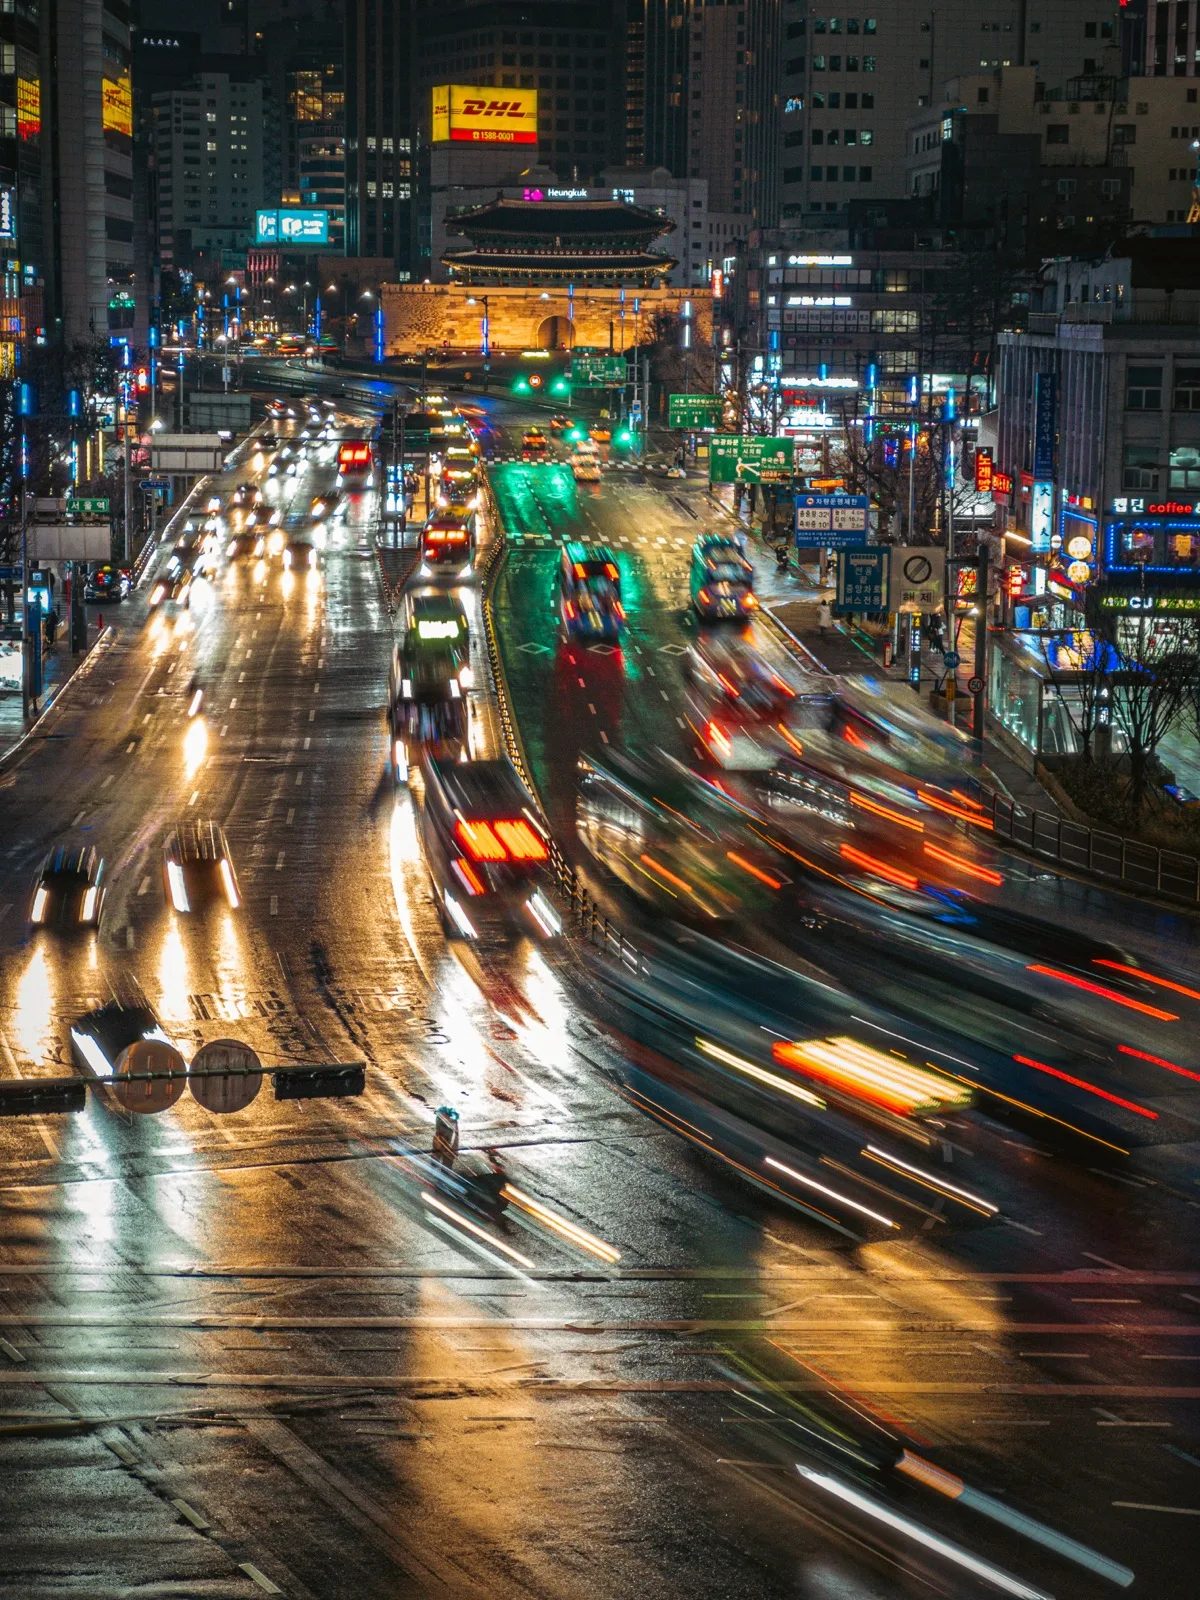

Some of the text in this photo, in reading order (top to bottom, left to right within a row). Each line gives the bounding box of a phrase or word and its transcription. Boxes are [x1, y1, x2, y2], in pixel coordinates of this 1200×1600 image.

[143, 37, 180, 47] PLAZA
[462, 99, 526, 118] DHL
[481, 131, 514, 140] 1588-0001
[547, 188, 588, 198] Heungkuk
[978, 454, 992, 492] 노래방
[71, 500, 105, 510] 서울역
[816, 498, 858, 506] 차량운행제한
[1149, 502, 1193, 514] coffee
[855, 567, 873, 576] 전용
[846, 584, 881, 593] 중앙차로
[845, 596, 881, 605] 버스전용
[902, 592, 932, 602] 해제
[1129, 596, 1153, 609] CU
[971, 680, 982, 690] 50
